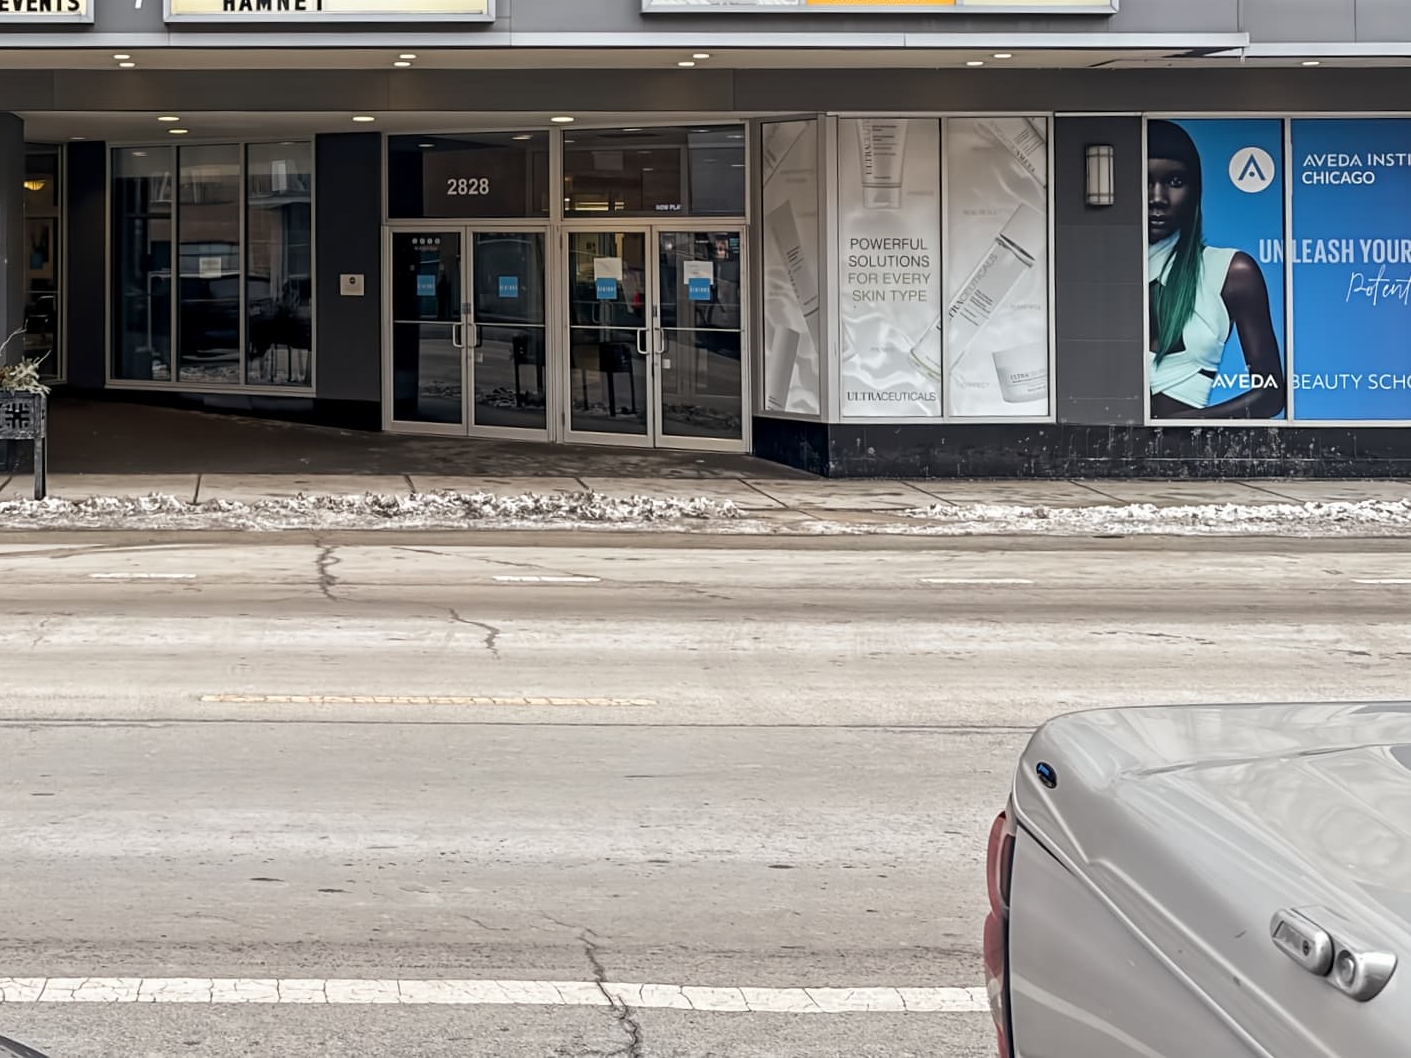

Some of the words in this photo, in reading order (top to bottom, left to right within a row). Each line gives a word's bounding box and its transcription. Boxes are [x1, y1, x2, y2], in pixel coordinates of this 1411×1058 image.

[1303, 153, 1363, 167] AVEDA
[1301, 170, 1376, 185] CHICAGO
[447, 178, 490, 195] 2828
[850, 238, 928, 251] POWERFUL
[1259, 239, 1353, 263] UNLEASH
[1359, 239, 1411, 263] YOUR
[848, 255, 930, 268] SOLUTIONS
[848, 272, 879, 285] FOR
[882, 272, 931, 285] EVERY
[852, 290, 886, 302] SKIN
[890, 290, 927, 302] TYPE
[1212, 374, 1279, 389] AVEDA
[1293, 374, 1363, 389] BEAUTY
[846, 392, 937, 402] ULTRACEUTICALS
